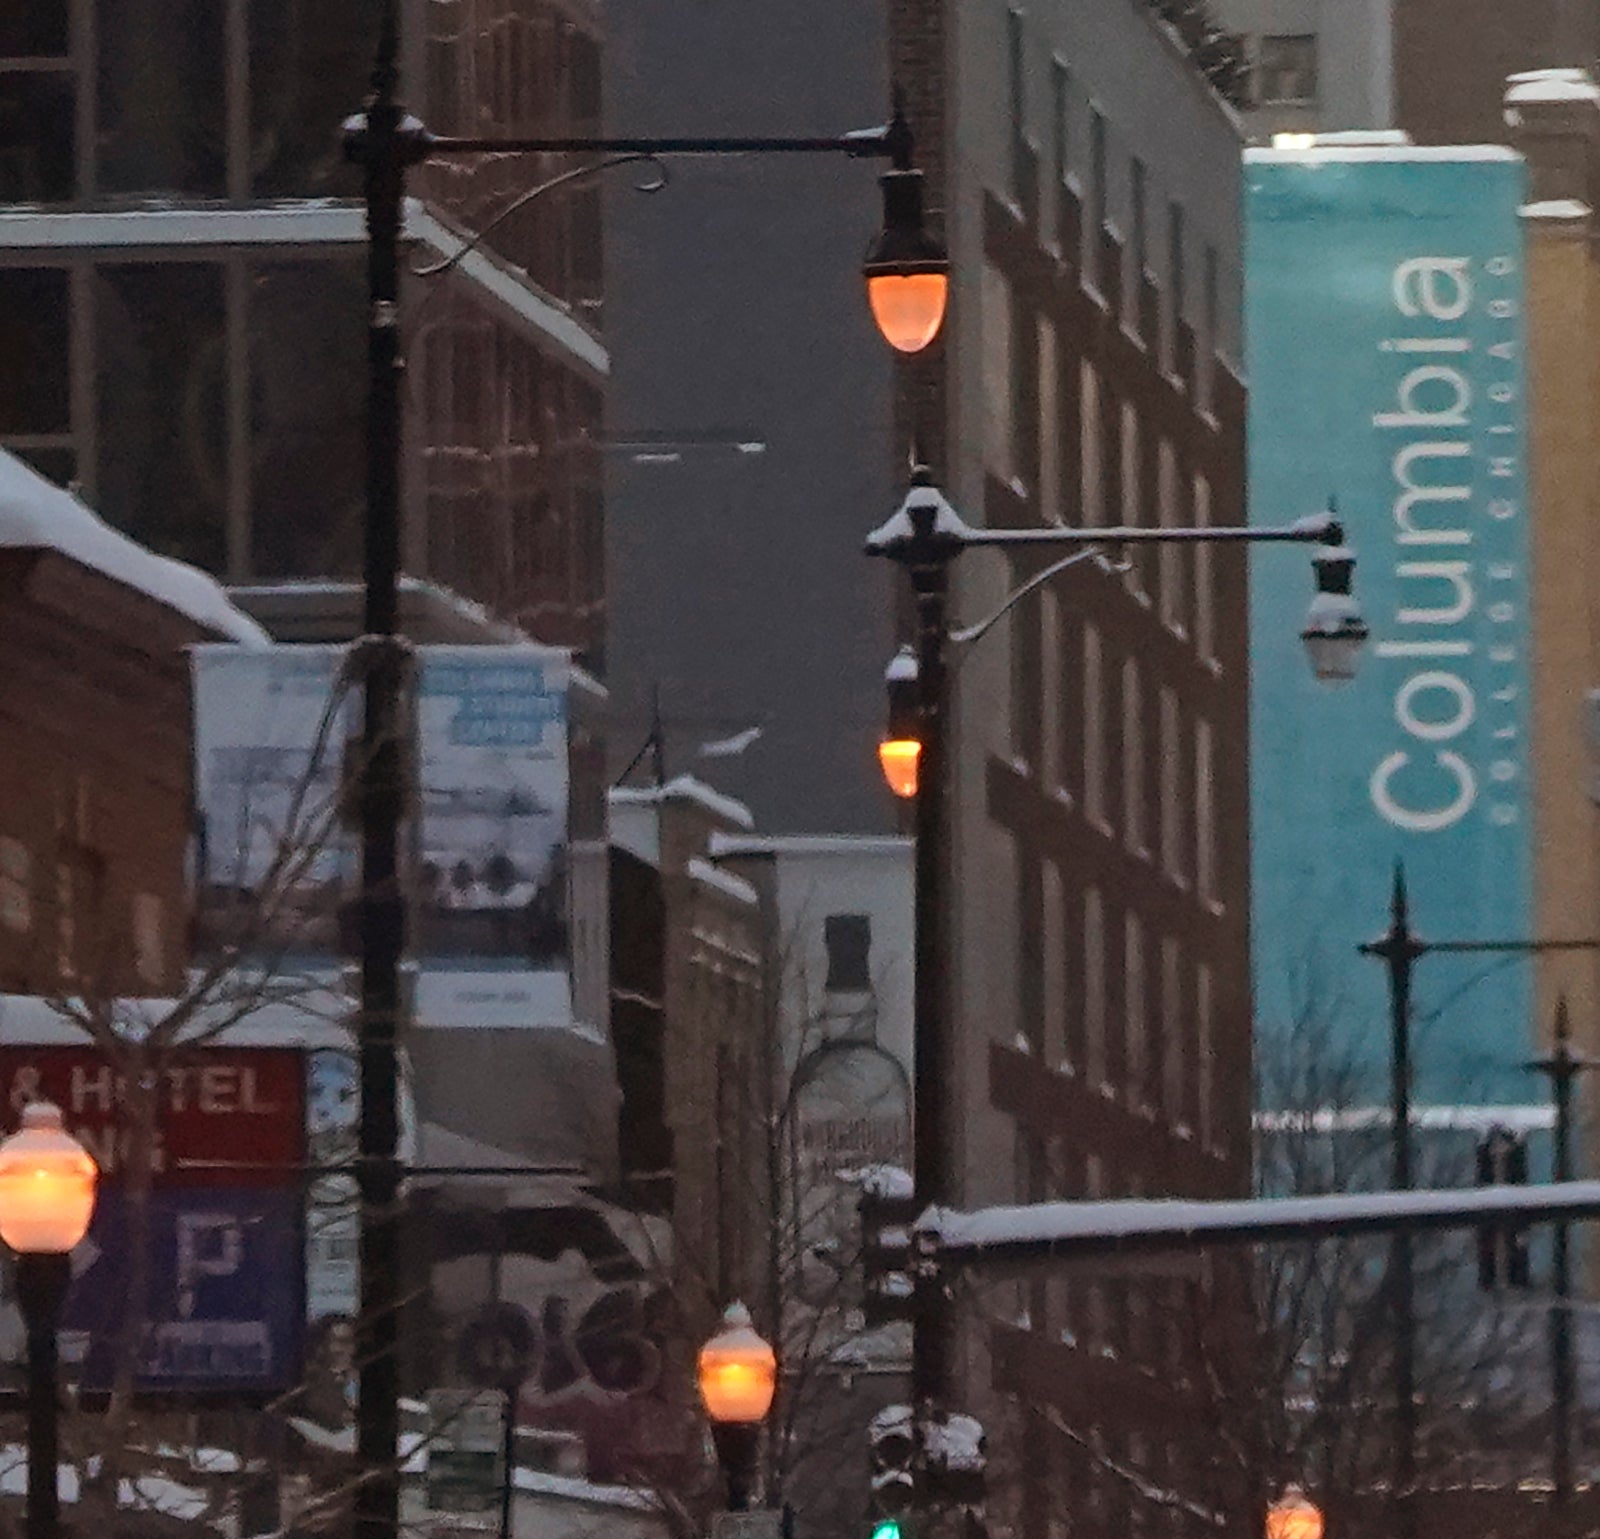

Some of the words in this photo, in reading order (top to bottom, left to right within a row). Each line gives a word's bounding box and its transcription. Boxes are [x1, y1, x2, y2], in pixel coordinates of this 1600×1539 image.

[1369, 256, 1476, 831] Columbia
[70, 1064, 279, 1114] HTEL
[175, 1213, 243, 1318] P
